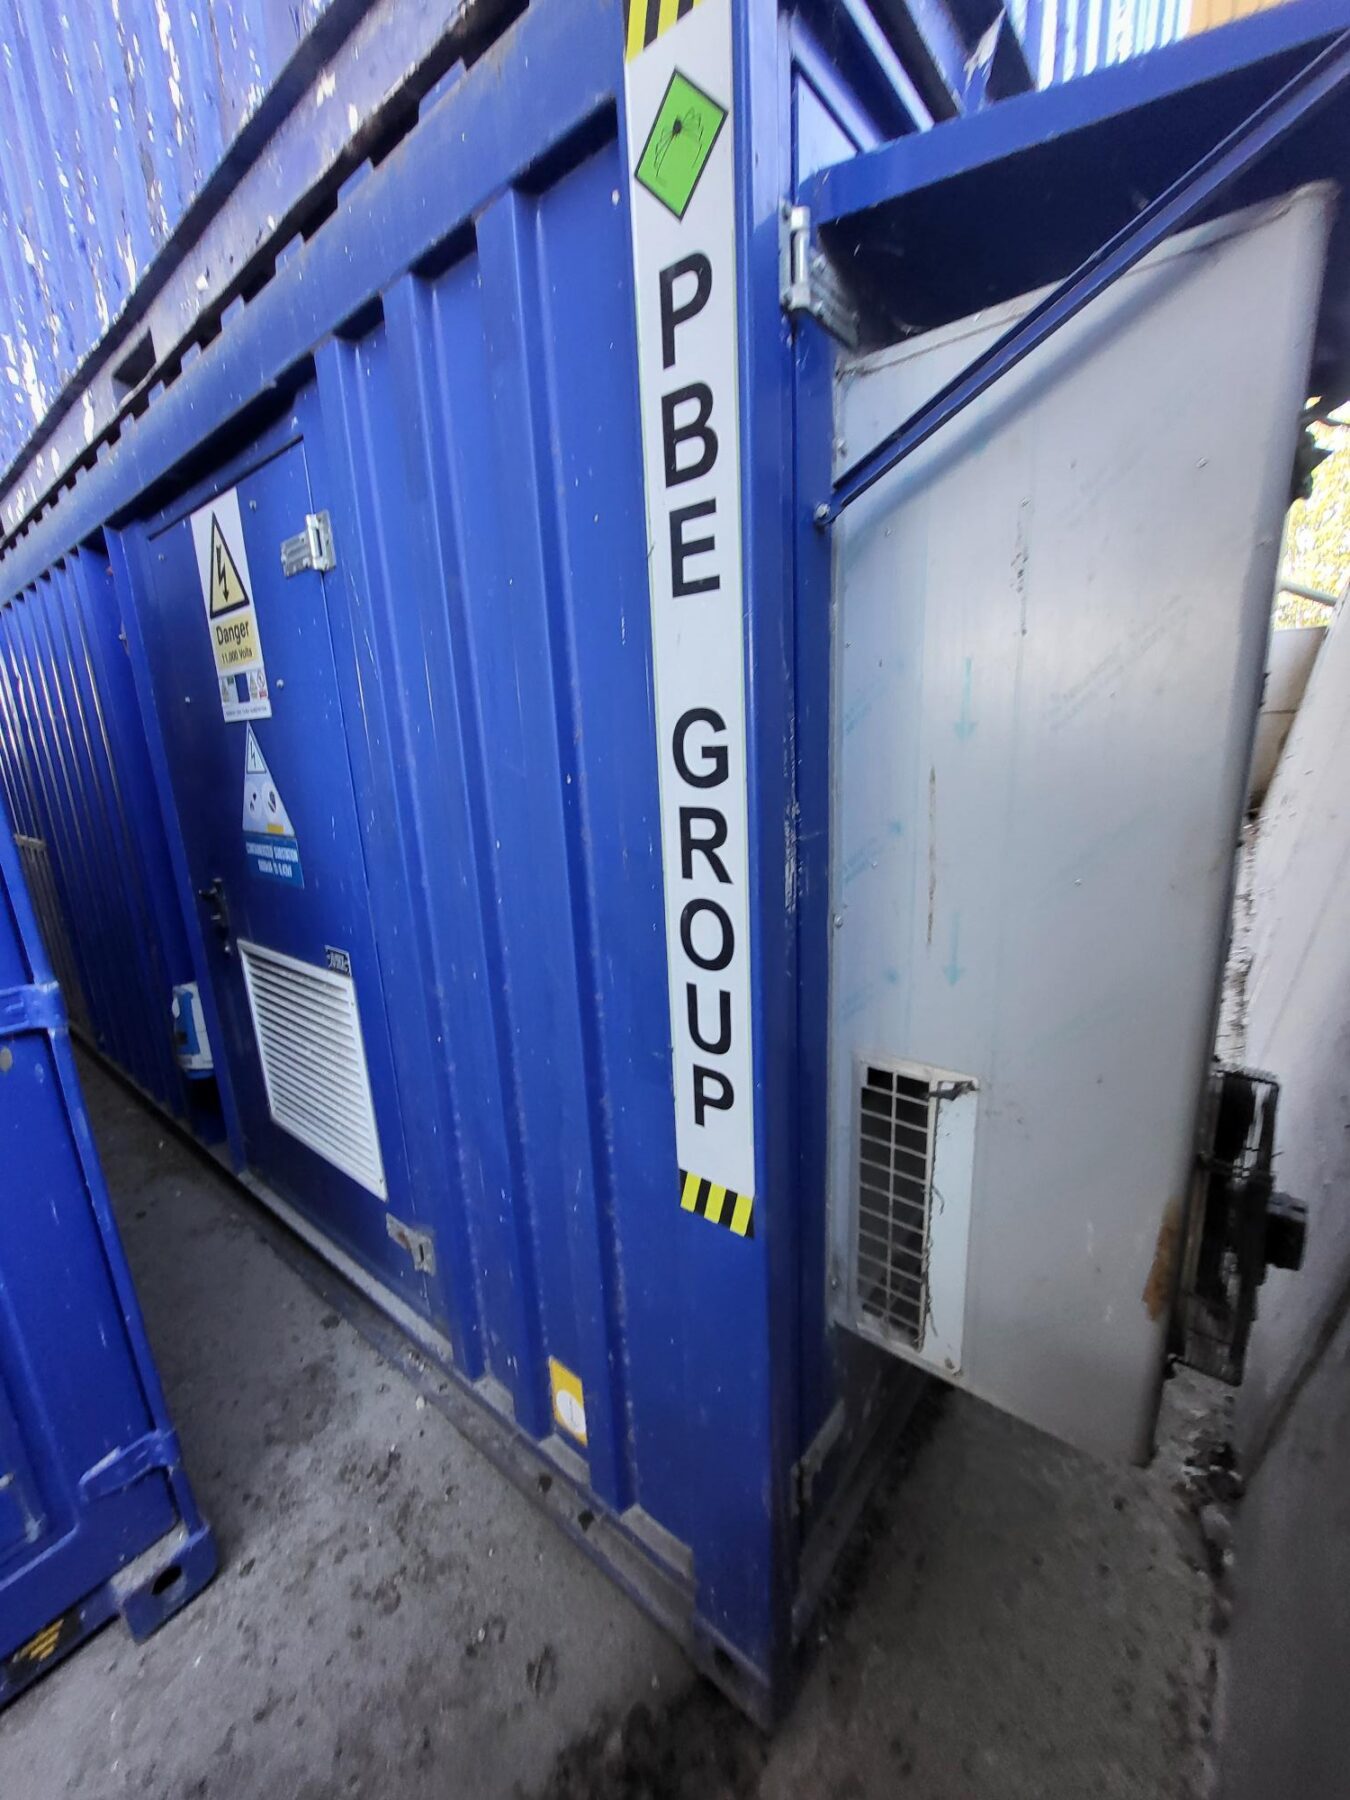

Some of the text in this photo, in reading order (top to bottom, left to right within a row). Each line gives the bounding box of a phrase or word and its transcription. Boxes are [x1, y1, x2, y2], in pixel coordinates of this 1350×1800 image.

[215, 621, 249, 646] Danger
[659, 252, 735, 1128] PBE GROUP
